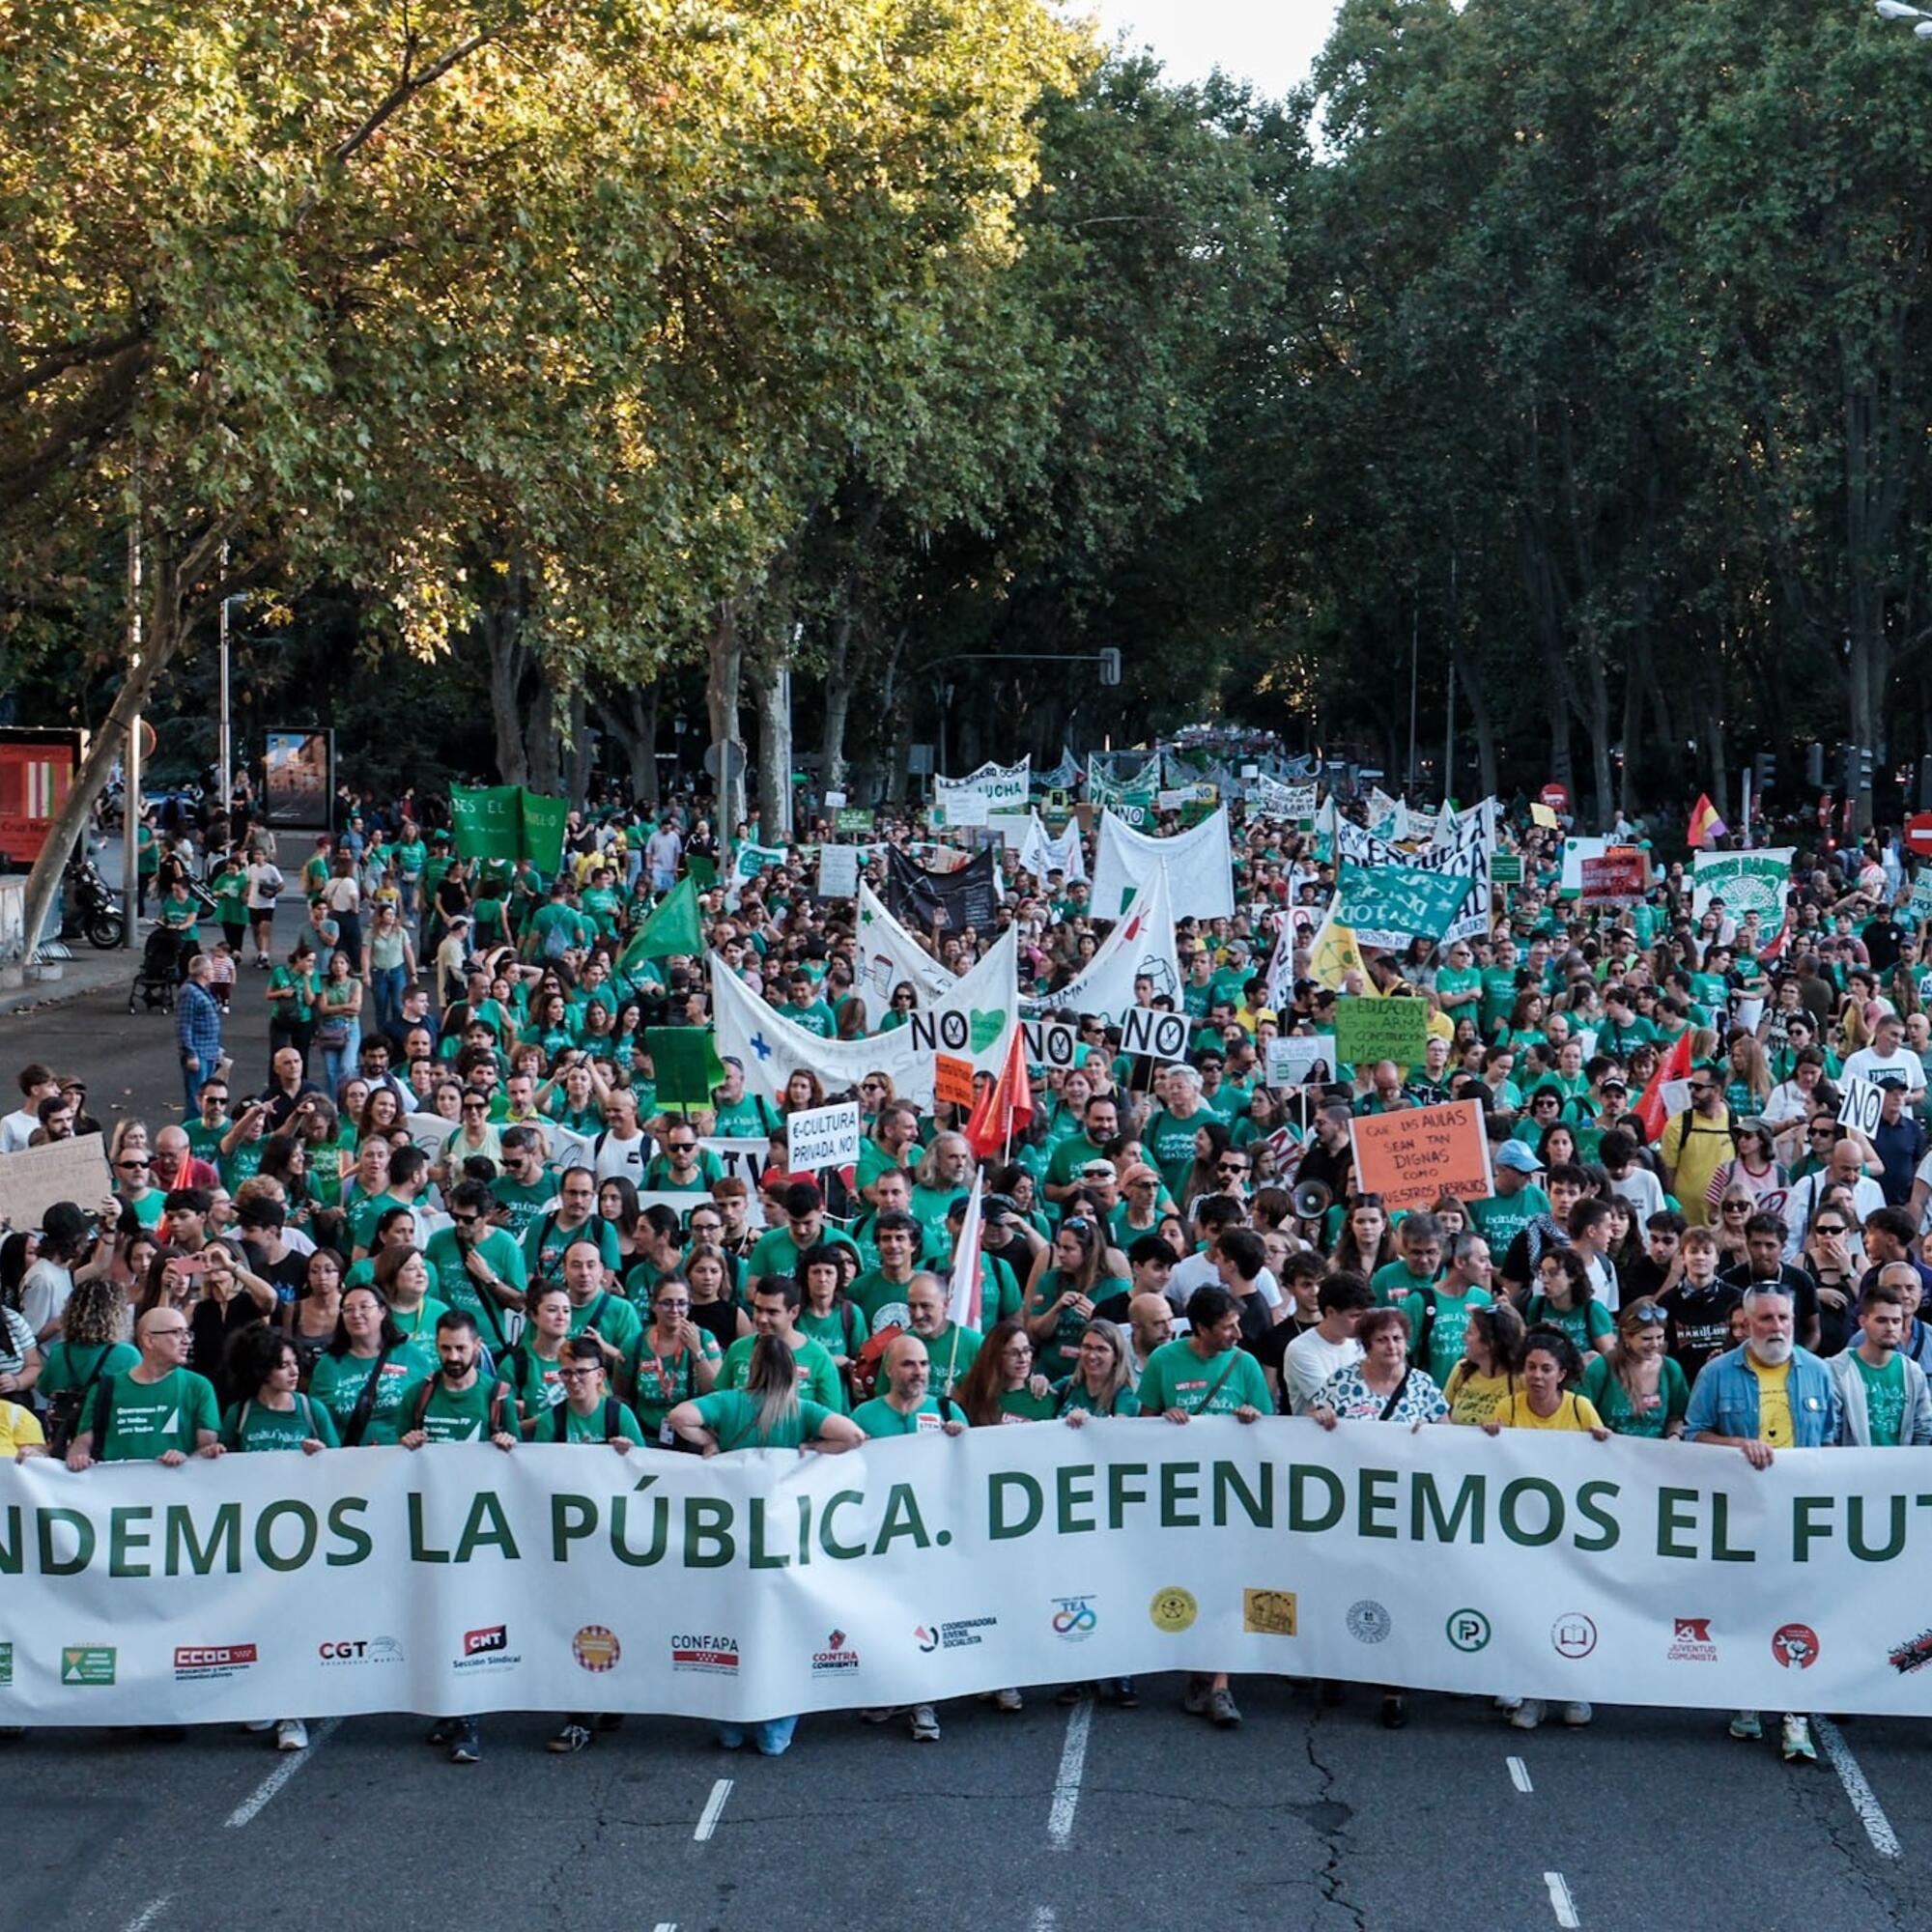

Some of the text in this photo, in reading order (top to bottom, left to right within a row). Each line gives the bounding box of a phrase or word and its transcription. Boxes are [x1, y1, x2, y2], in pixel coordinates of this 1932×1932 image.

[979, 782, 1022, 799] UCHA
[910, 1009, 967, 1051] NO
[1124, 1009, 1185, 1056] NO
[1021, 1021, 1073, 1065] NO
[1841, 1078, 1881, 1133] NO
[1422, 1110, 1467, 1128] AULAS
[1383, 1134, 1451, 1153] SEAN TAN
[1393, 1150, 1450, 1170] DIGNAS
[1403, 1168, 1438, 1180] COMO
[407, 1491, 521, 1563] LA
[551, 1475, 952, 1569] PÚBLICA.
[988, 1461, 1620, 1552] DEFENDEMOS
[1657, 1486, 1756, 1562] EL
[1062, 1601, 1088, 1612] TEA
[469, 1632, 501, 1649] CNT
[671, 1634, 739, 1652] CONFAPA
[1668, 1644, 1717, 1654] JUVENTUD
[177, 1649, 231, 1664] CCOO
[319, 1641, 368, 1660] CGT
[812, 1651, 858, 1662] CONTRA
[1667, 1653, 1719, 1662] COMUNISTA
[452, 1655, 522, 1668] Sección Sindical
[812, 1660, 859, 1669] CORRIENTE
